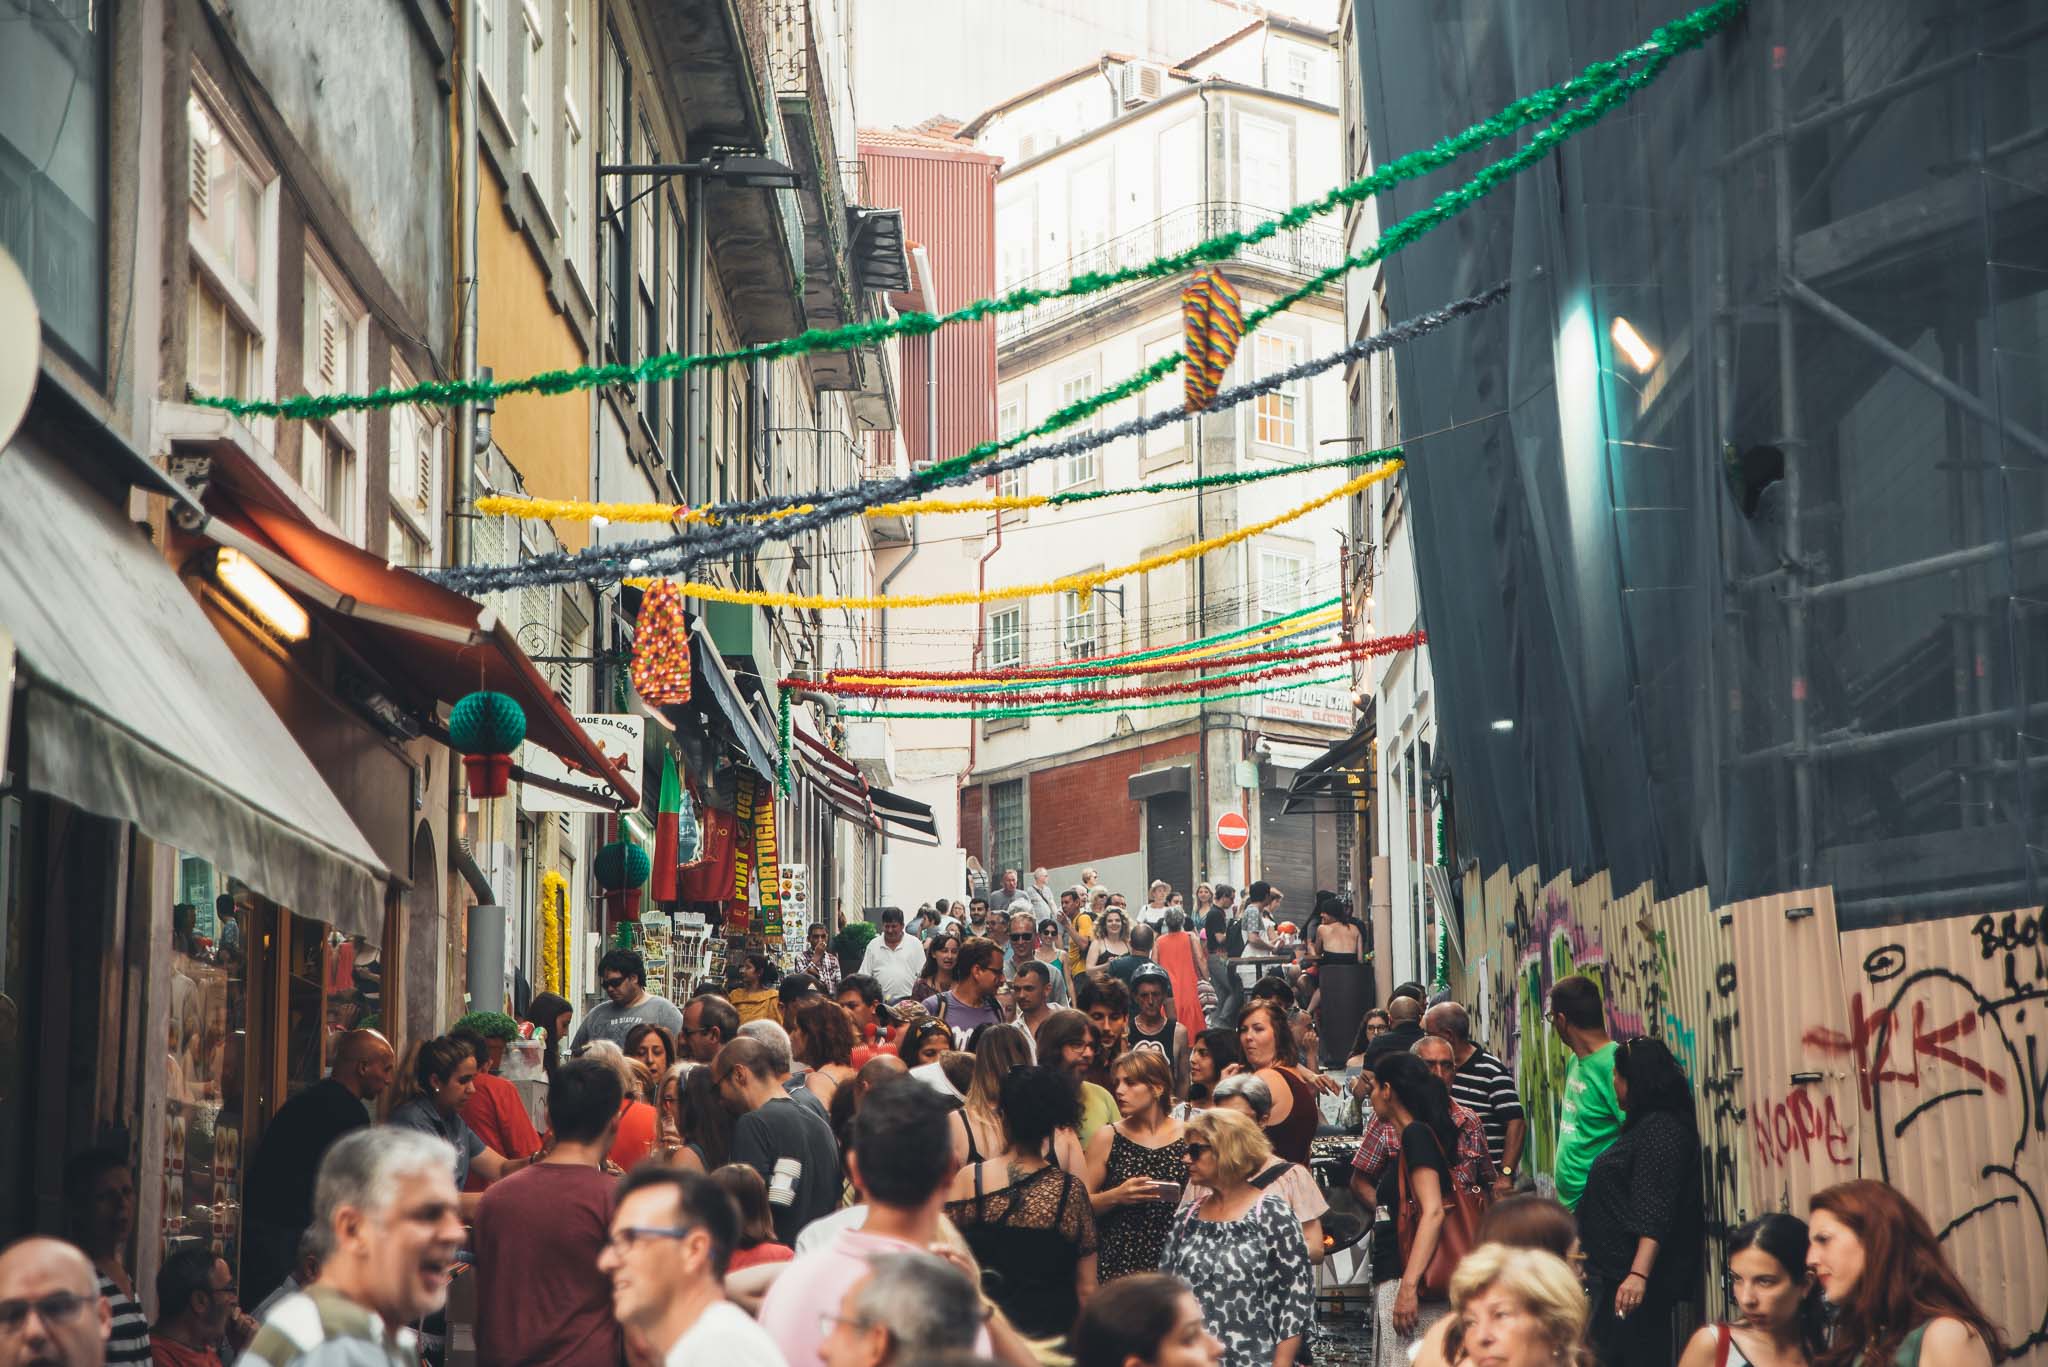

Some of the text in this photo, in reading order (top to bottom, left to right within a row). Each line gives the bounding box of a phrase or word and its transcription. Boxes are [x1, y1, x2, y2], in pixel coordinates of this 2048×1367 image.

[601, 718, 614, 727] DA
[616, 721, 638, 739] CASA
[755, 802, 780, 906] PORTUGAL
